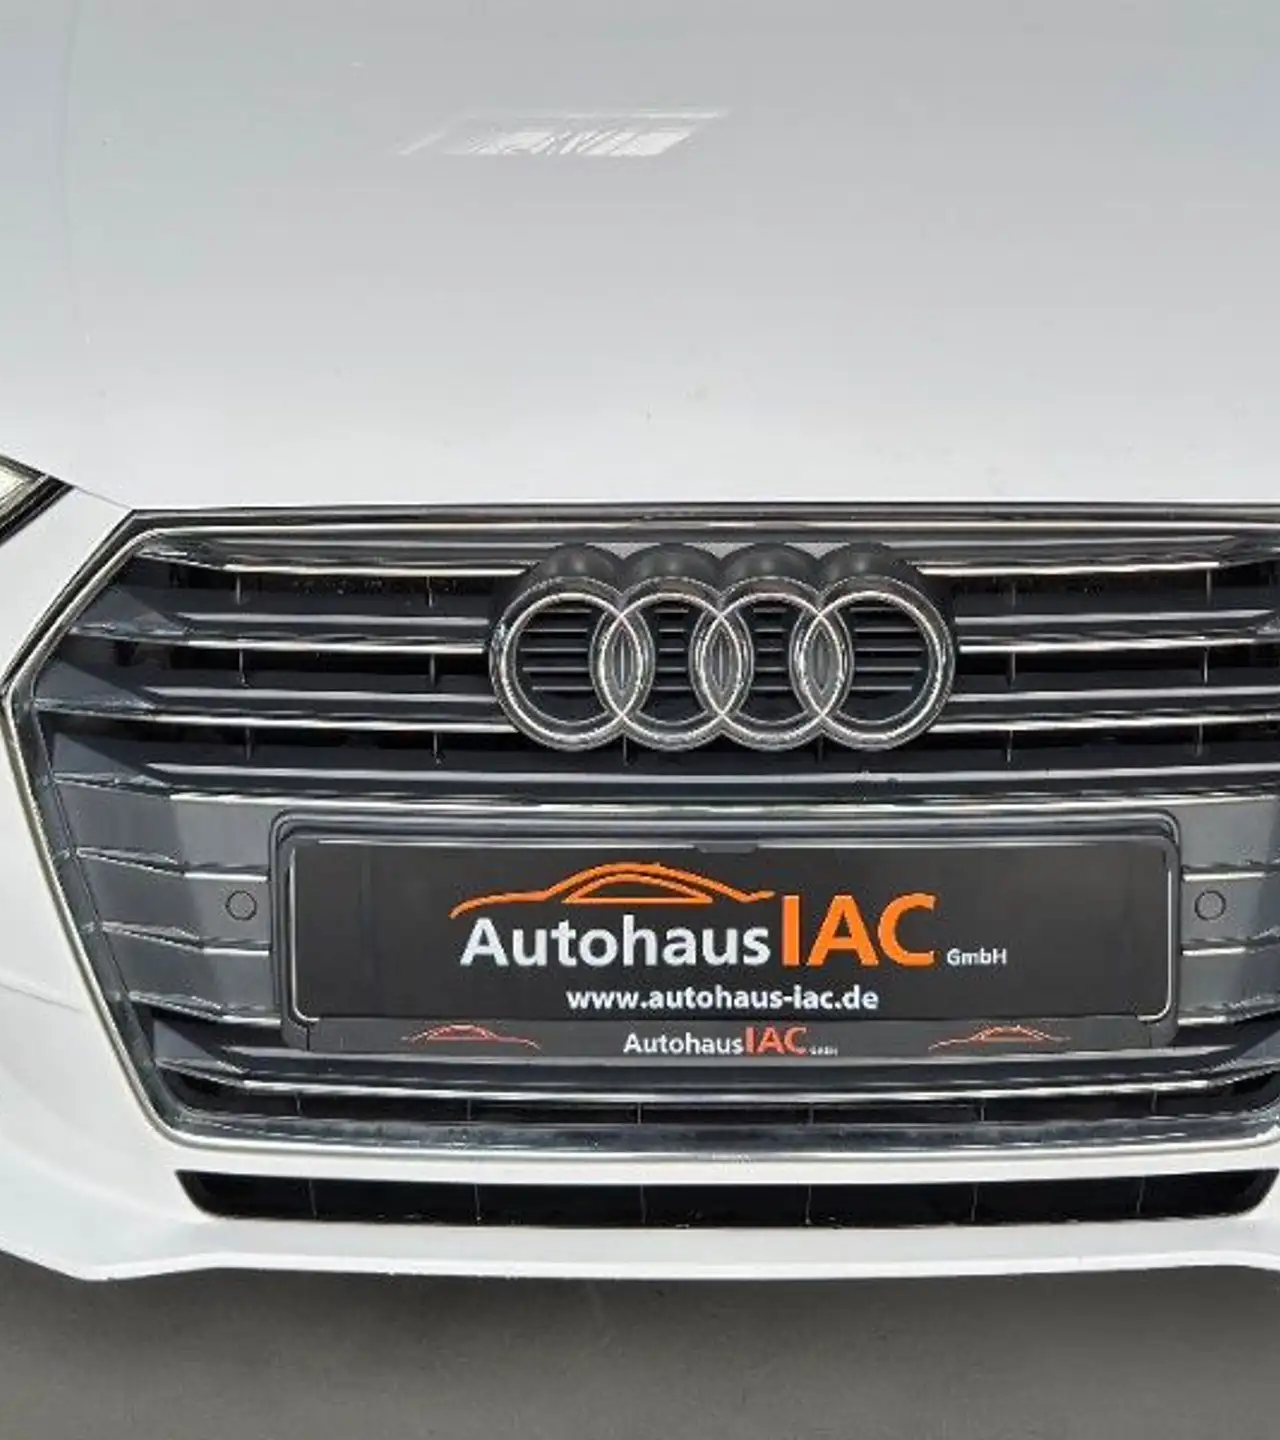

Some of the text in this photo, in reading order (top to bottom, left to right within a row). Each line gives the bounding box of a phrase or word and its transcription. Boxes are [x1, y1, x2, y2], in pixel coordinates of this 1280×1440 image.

[459, 893, 1008, 967] Autohaus IAC GmbH
[565, 984, 880, 1012] www.autohaus-iac.de
